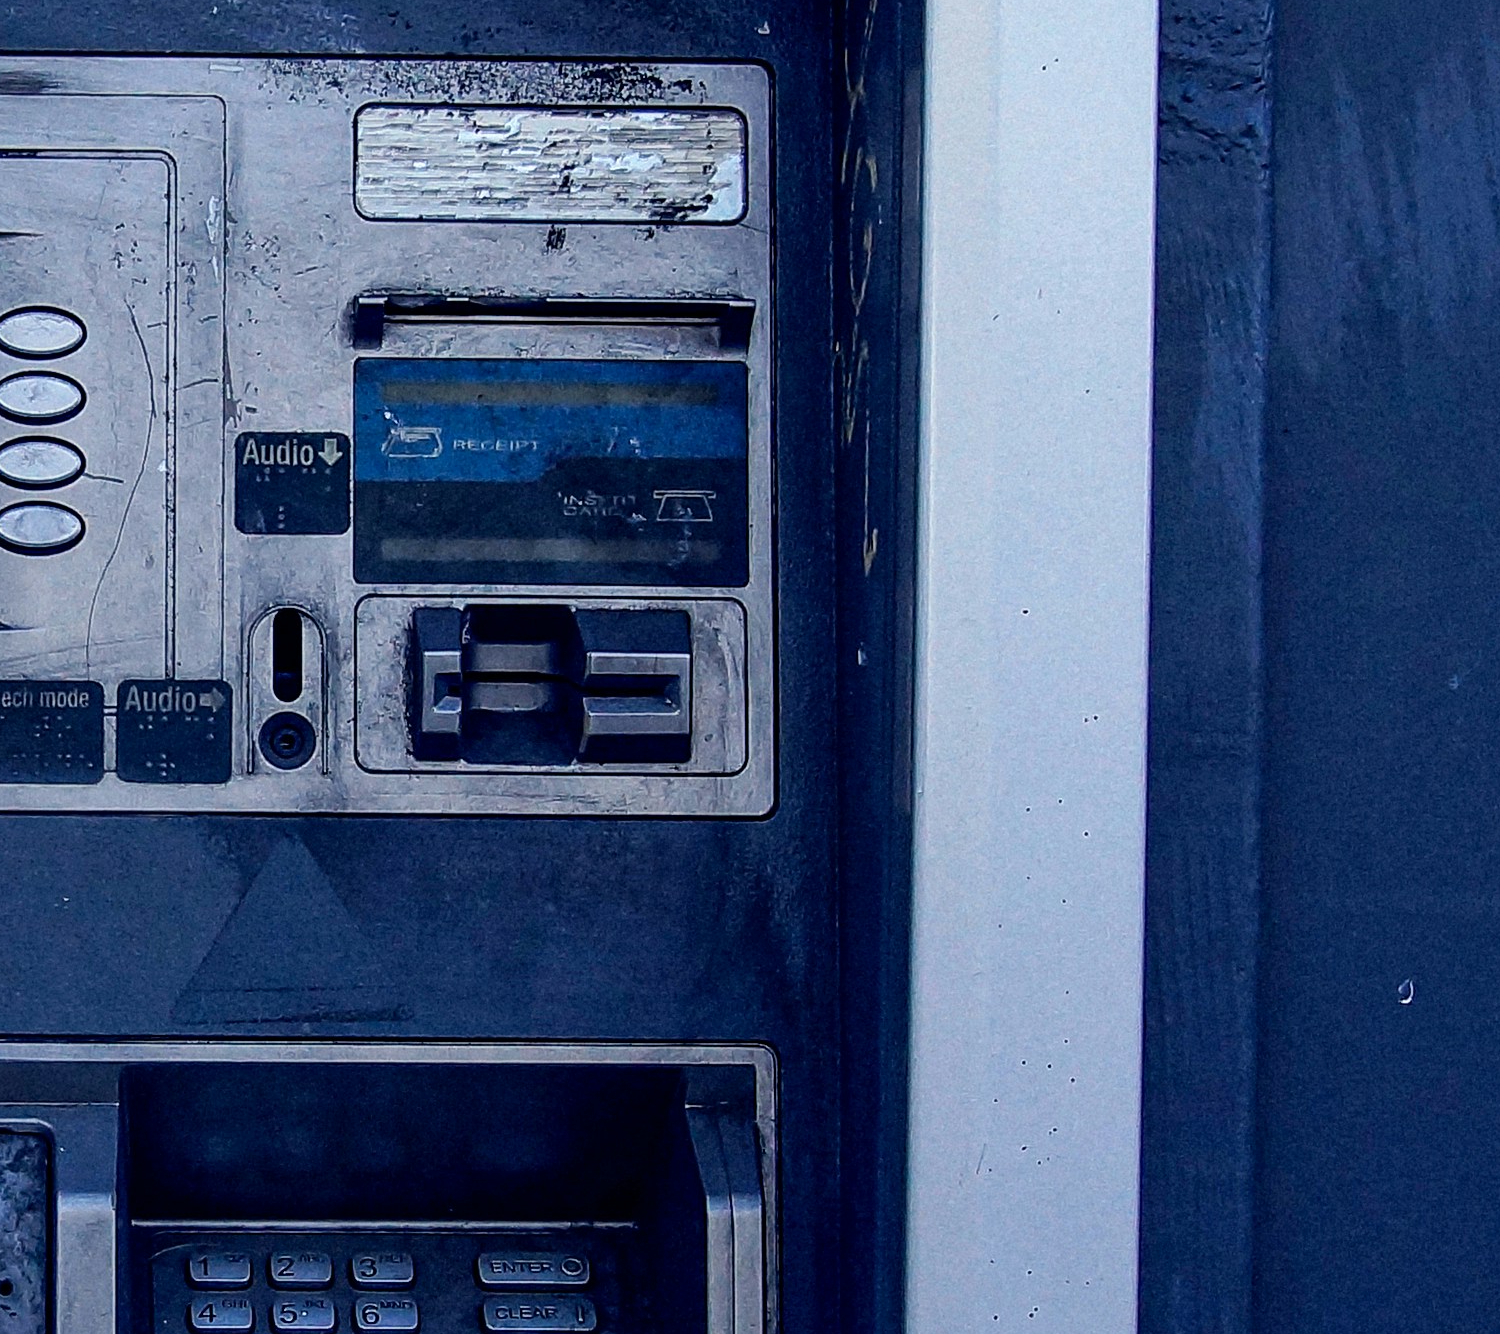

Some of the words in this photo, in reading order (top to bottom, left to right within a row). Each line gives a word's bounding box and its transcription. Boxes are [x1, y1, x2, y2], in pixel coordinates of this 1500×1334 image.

[243, 437, 314, 467] Audio
[453, 438, 539, 452] RECEIPT
[40, 686, 90, 709] mode
[125, 684, 196, 714] Audio
[197, 1255, 208, 1276] 1
[277, 1255, 295, 1277] 2
[359, 1255, 378, 1278] 3
[490, 1259, 554, 1274] ENTER
[198, 1303, 217, 1324] 4
[279, 1303, 298, 1325] 5
[362, 1304, 380, 1325] 6
[494, 1305, 559, 1321] CLEAR
